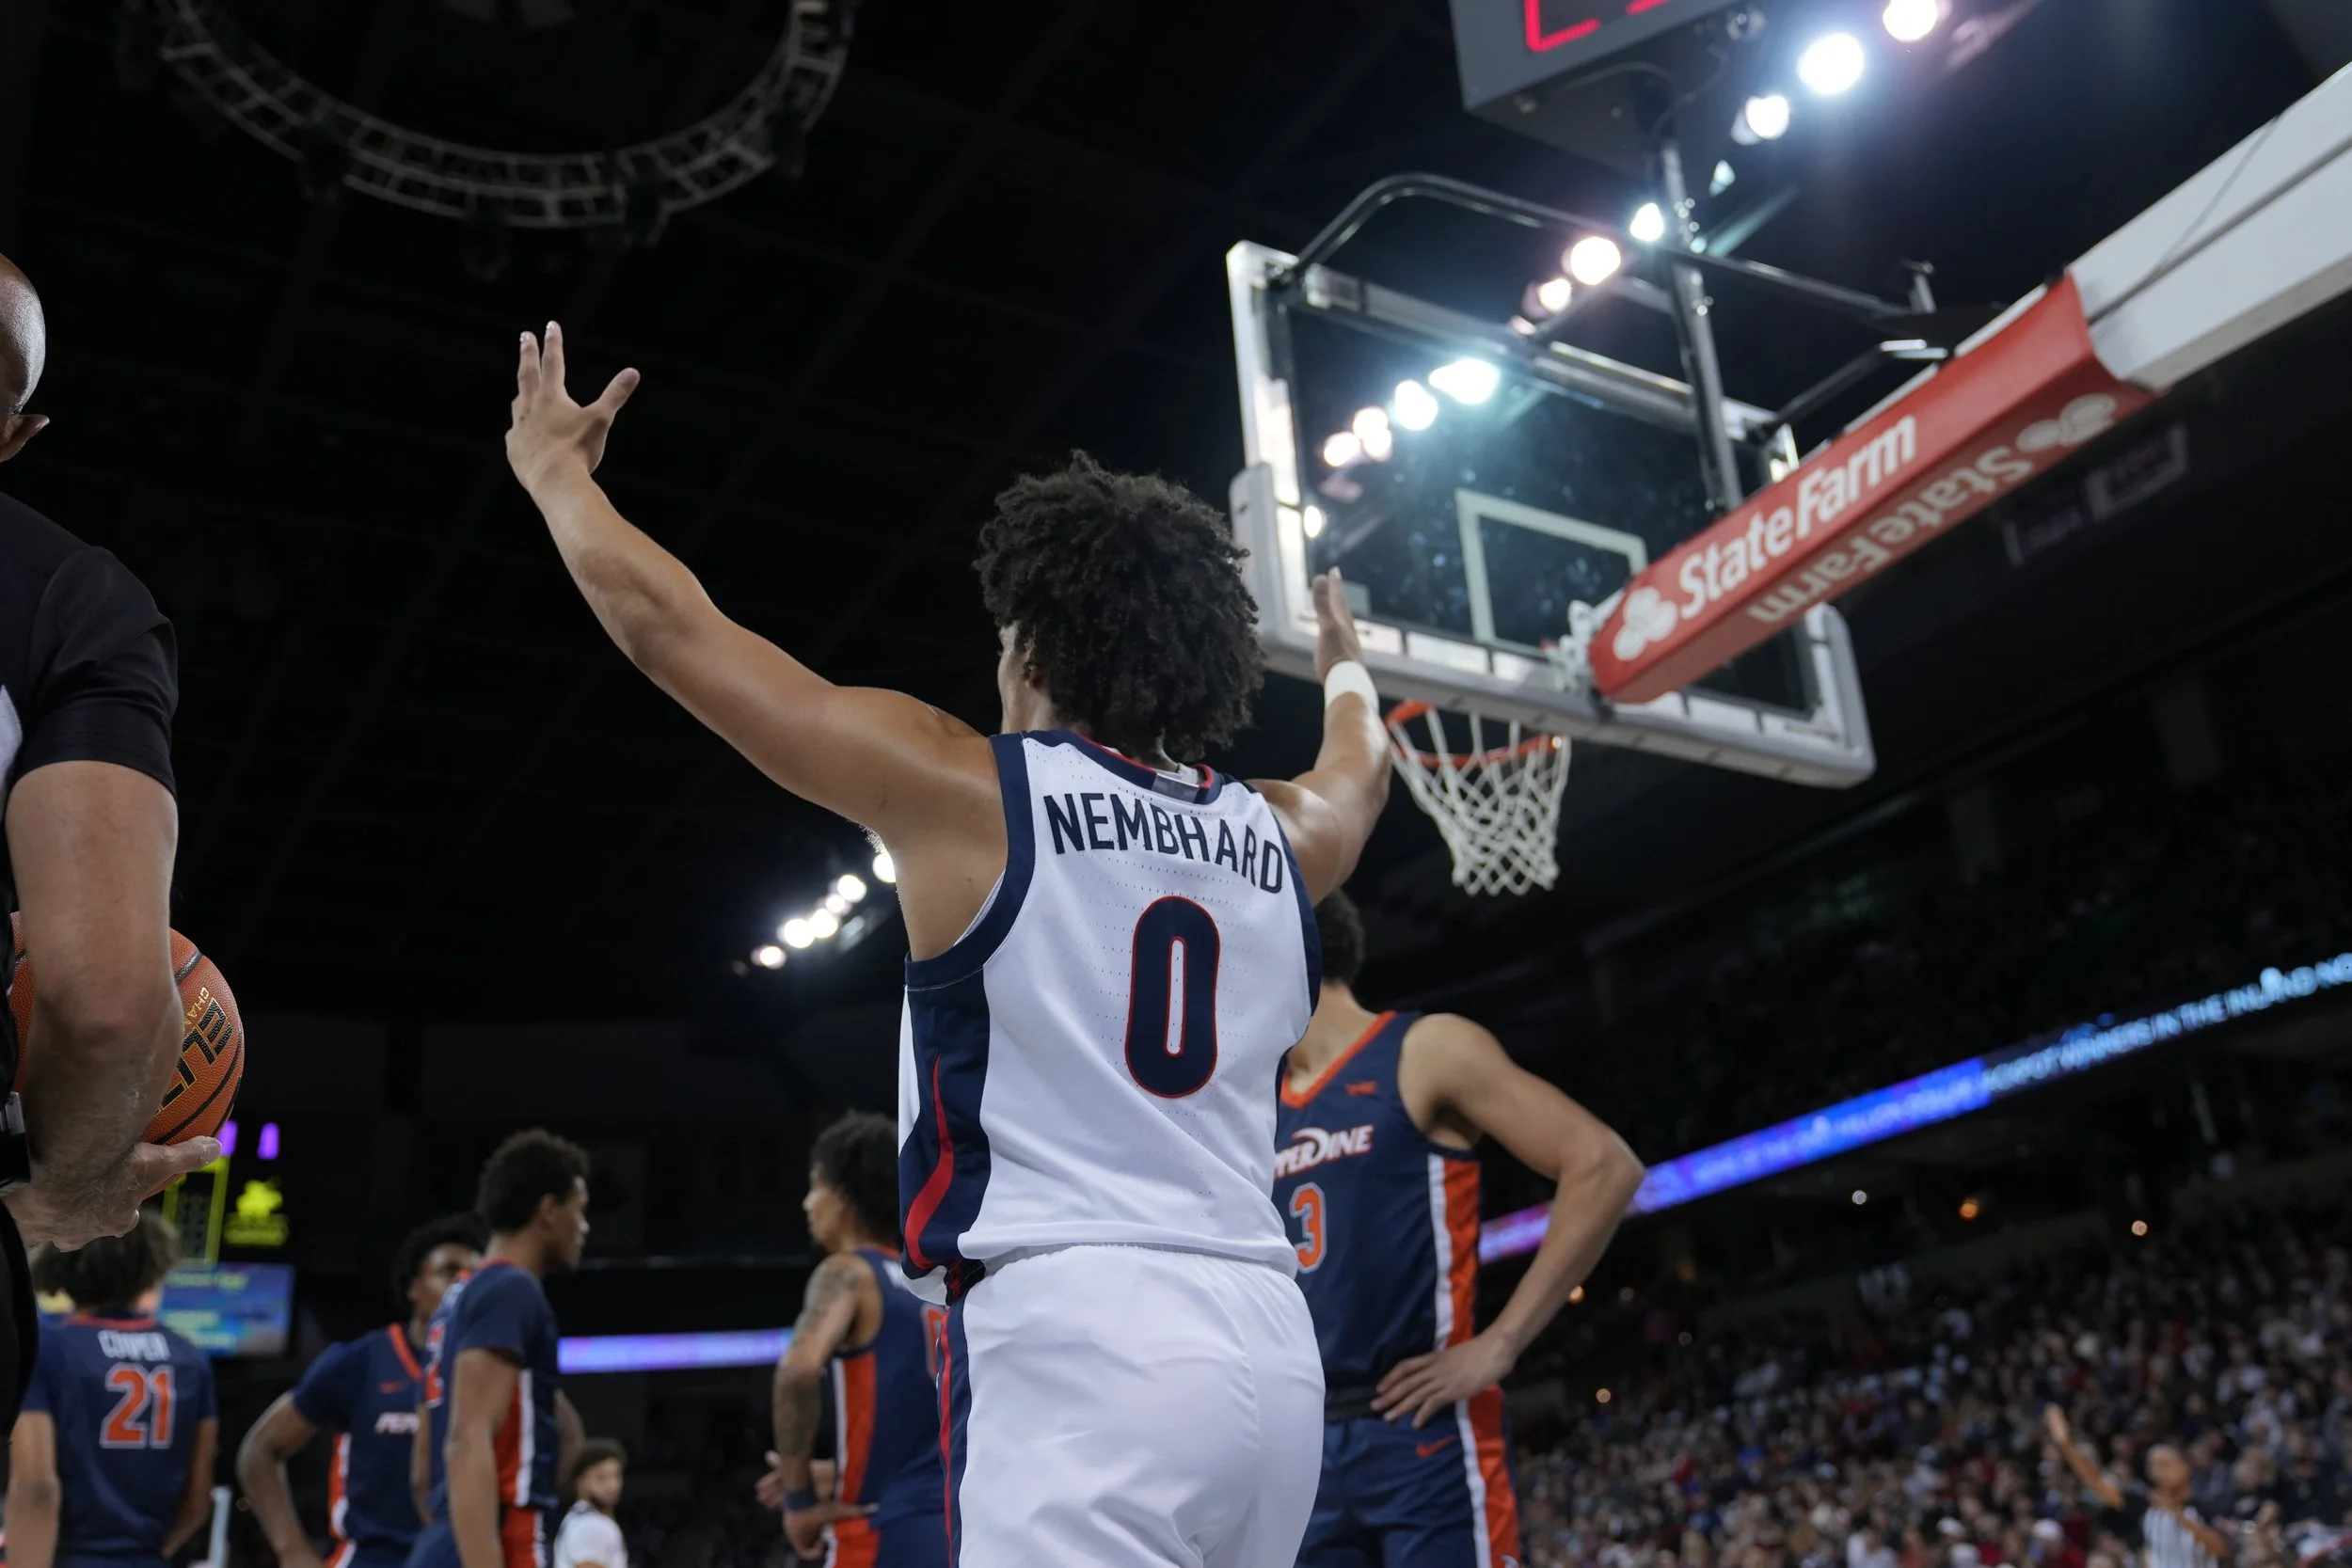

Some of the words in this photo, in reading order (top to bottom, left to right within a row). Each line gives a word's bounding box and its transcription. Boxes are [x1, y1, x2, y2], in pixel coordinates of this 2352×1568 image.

[1043, 793, 1283, 895] NEMBHARD
[1125, 895, 1221, 1099] 0
[1289, 1182, 1327, 1274] 3
[100, 1363, 177, 1449] 21
